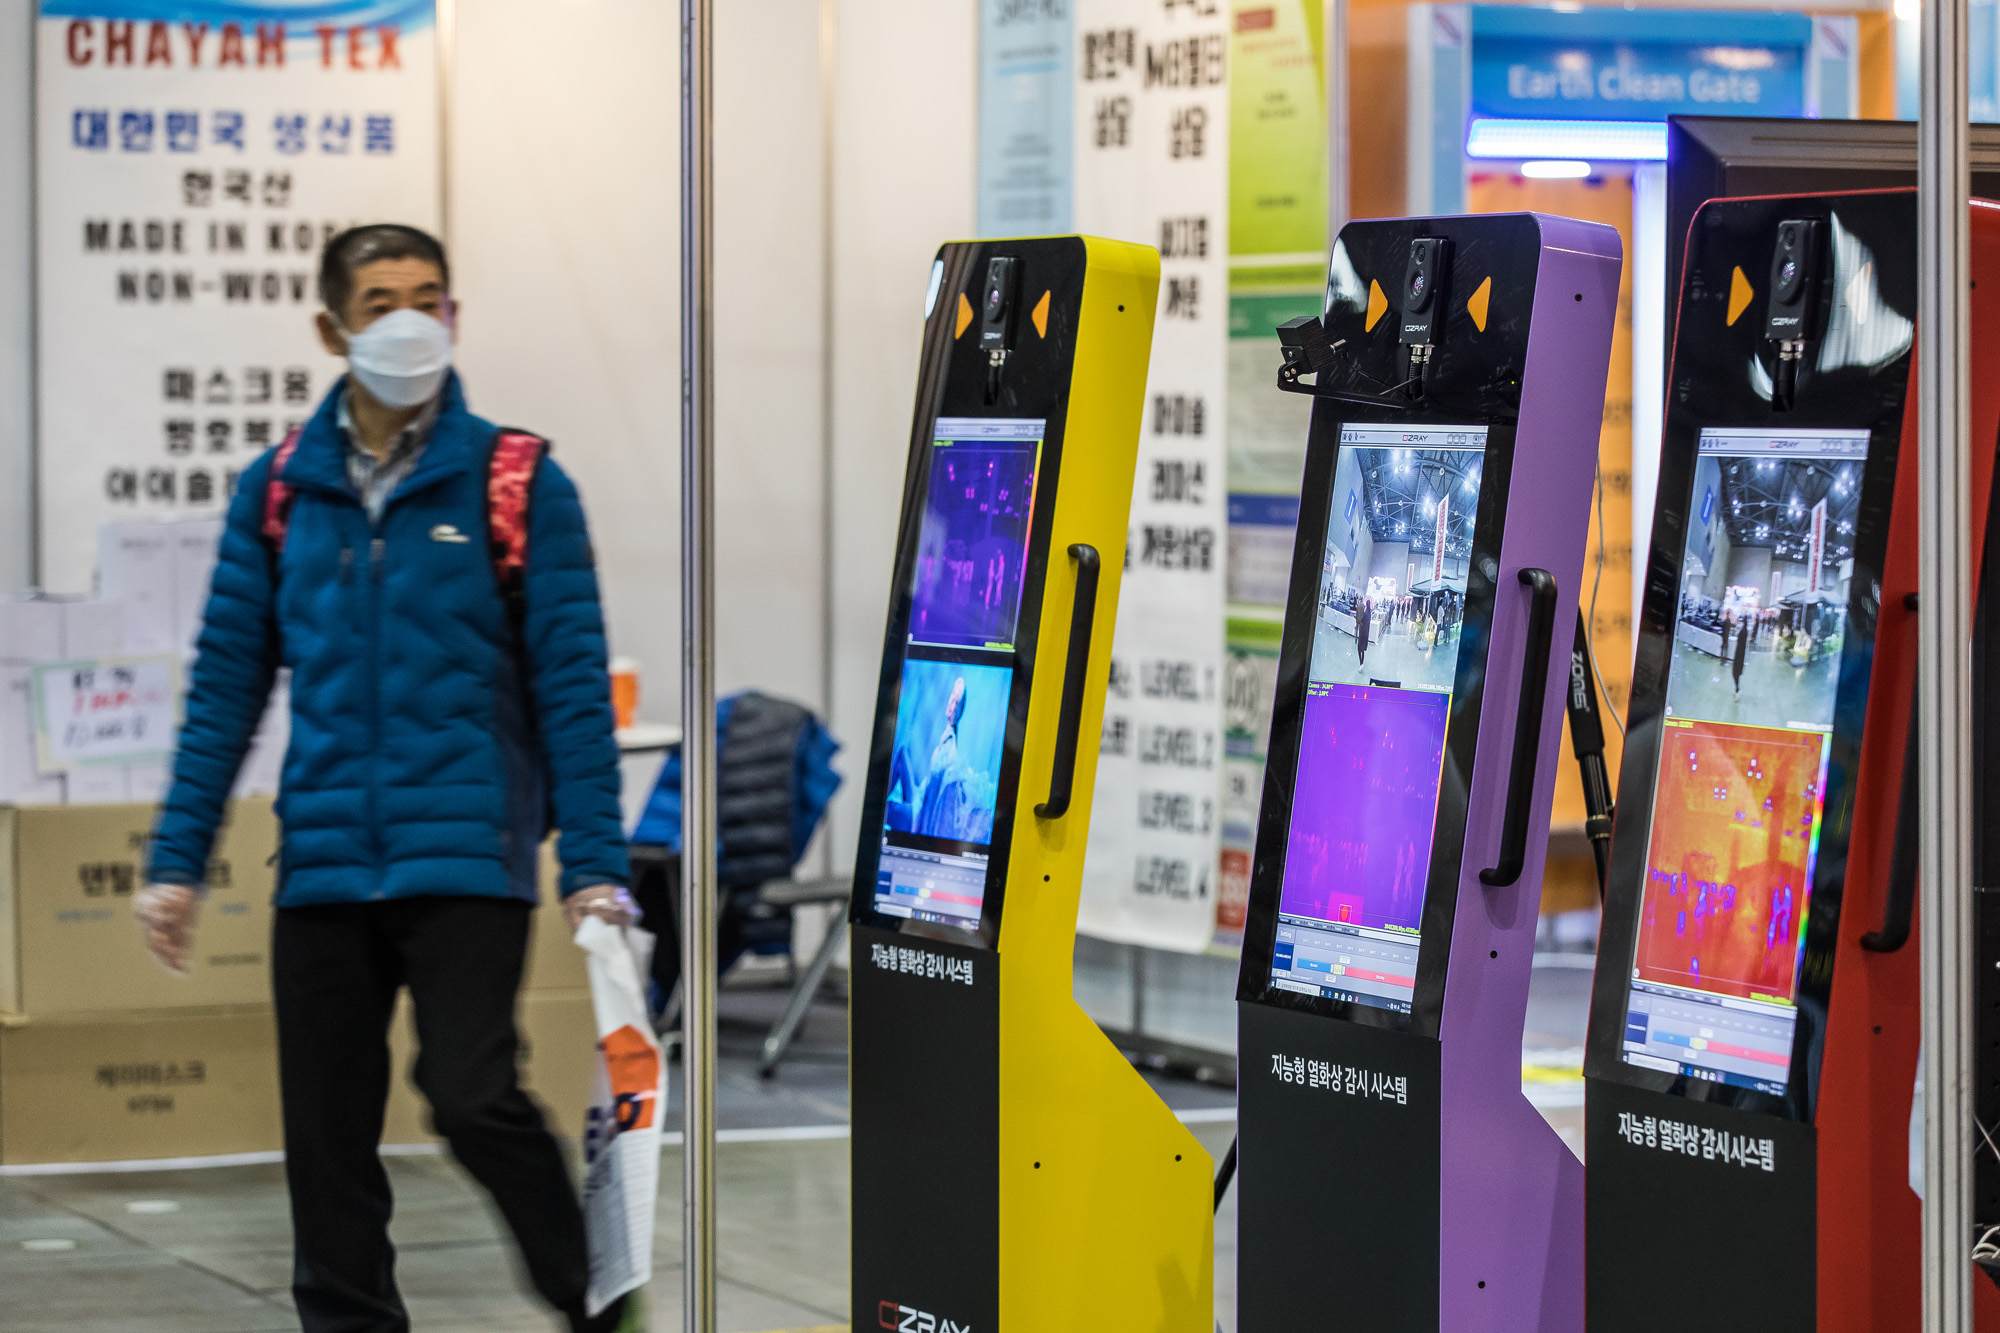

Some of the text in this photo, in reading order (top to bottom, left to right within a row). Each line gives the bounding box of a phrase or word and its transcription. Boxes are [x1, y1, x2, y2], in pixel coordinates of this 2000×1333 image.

[65, 19, 405, 71] CHAYAH TEX
[1508, 61, 1761, 103] Earth Clean Gate
[72, 109, 396, 156] 대한민국 생산품
[182, 169, 293, 208] 한국산
[83, 219, 186, 254] MADE
[209, 221, 245, 254] IN
[163, 367, 313, 404] 마스크용
[164, 420, 300, 459] 방호복
[1138, 722, 1197, 768] LEVEL
[1138, 790, 1196, 834] LEVEL
[1134, 853, 1191, 901] LEVEL
[871, 942, 974, 986] 지능형 열화상 감시 시스템
[1271, 1053, 1407, 1105] 지능형 열화상 감시 시스템
[1618, 1111, 1775, 1172] 지능형 열화상 감시 시스템
